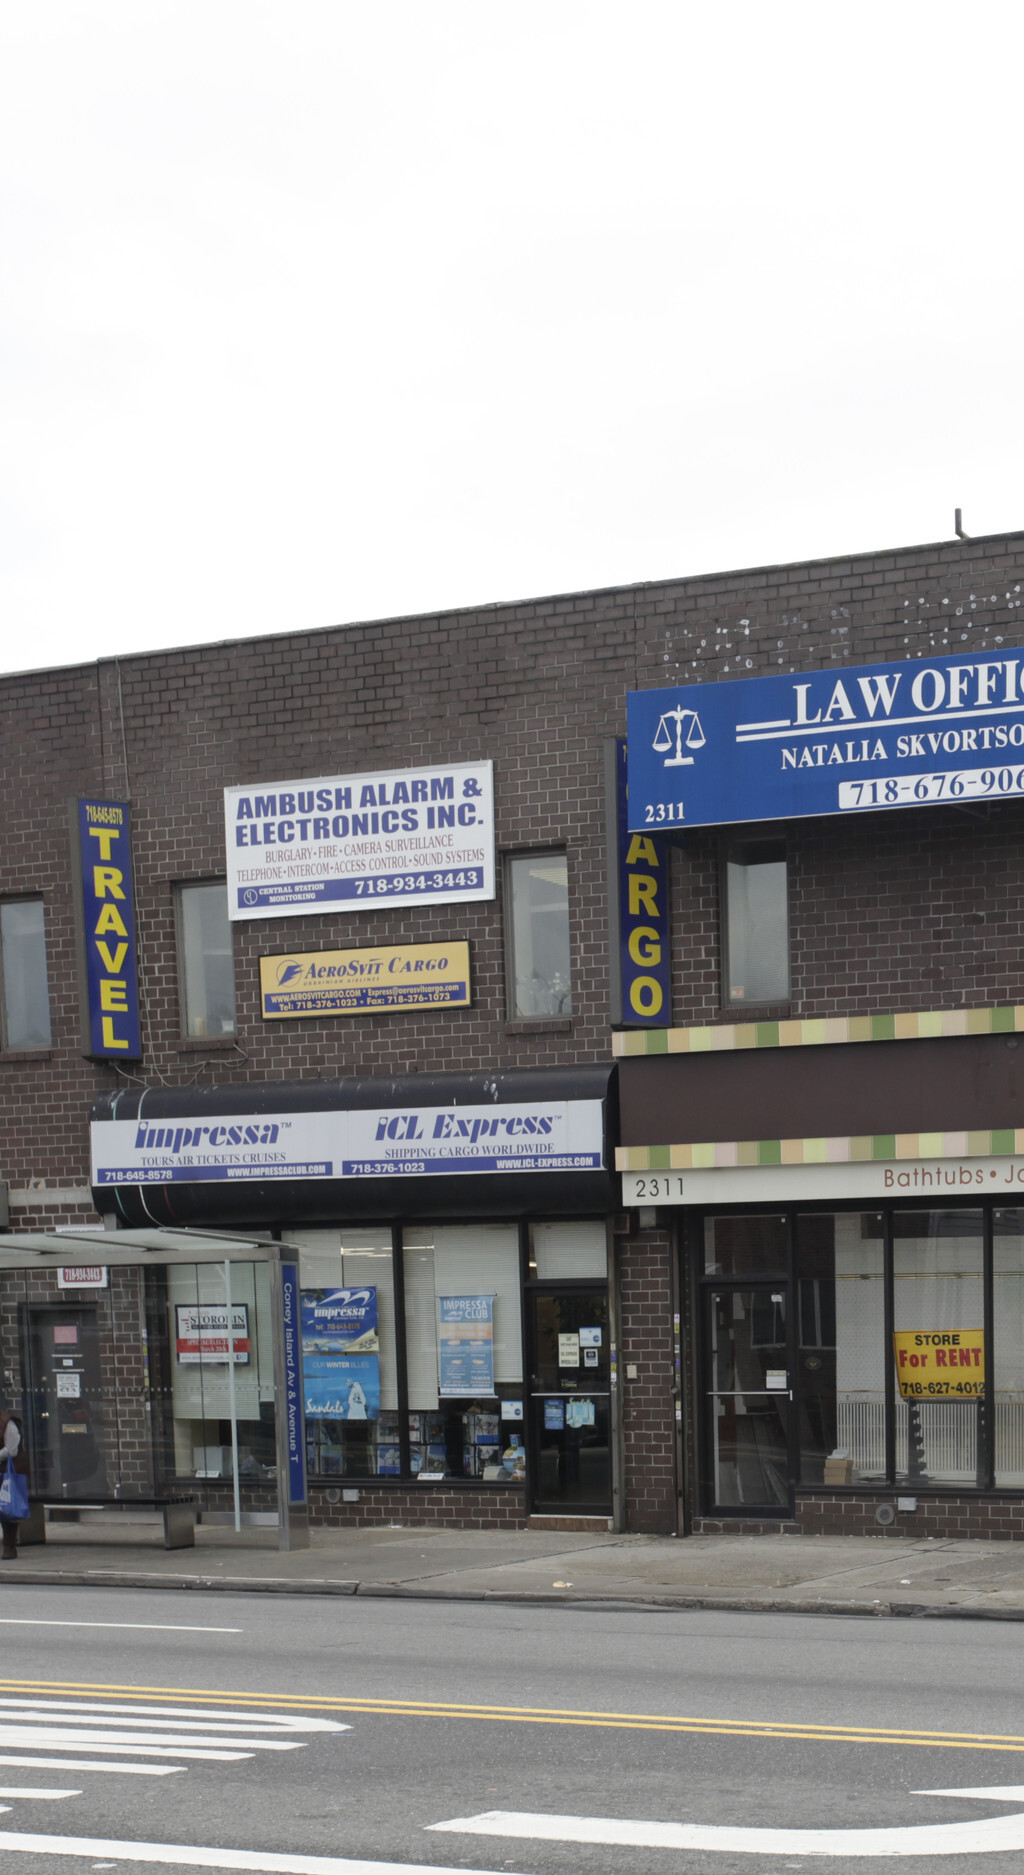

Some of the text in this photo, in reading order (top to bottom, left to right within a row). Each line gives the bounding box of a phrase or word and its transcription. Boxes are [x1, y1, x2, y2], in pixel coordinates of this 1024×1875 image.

[792, 673, 902, 727] LAW
[781, 738, 888, 771] NATALIA
[236, 776, 483, 820] AMBUSH ALARM &
[645, 802, 685, 823] 2311
[236, 803, 484, 847] ELECTRONICS INC.
[385, 834, 454, 853] SURVEILLANCE
[446, 848, 484, 863] SYSTEMS
[259, 883, 325, 895] CENTRAL STATION
[354, 871, 478, 894] 718-934-3443
[269, 893, 316, 903] MONITORING
[89, 827, 129, 1049] TRAVEL
[432, 1114, 554, 1144] Express
[141, 1152, 286, 1167] TOURS AIR TICKETS CRUISES
[384, 1143, 555, 1159] SHIPPING CARGO WORLDWIDE
[104, 1164, 327, 1181] 718-645-8578 WWW.IMPRESSACLUB.COM
[351, 1162, 425, 1174] 718-376-1023
[884, 1166, 984, 1187] Bathtubs
[636, 1177, 683, 1197] 2311
[443, 1300, 488, 1310] IMPRESSA
[465, 1309, 488, 1319] CLUB
[915, 1334, 960, 1346] STORE
[899, 1348, 981, 1368] For RENT
[284, 1283, 299, 1463] Coney Island Av & Avenue T
[901, 1381, 986, 1394] 718-627-4012
